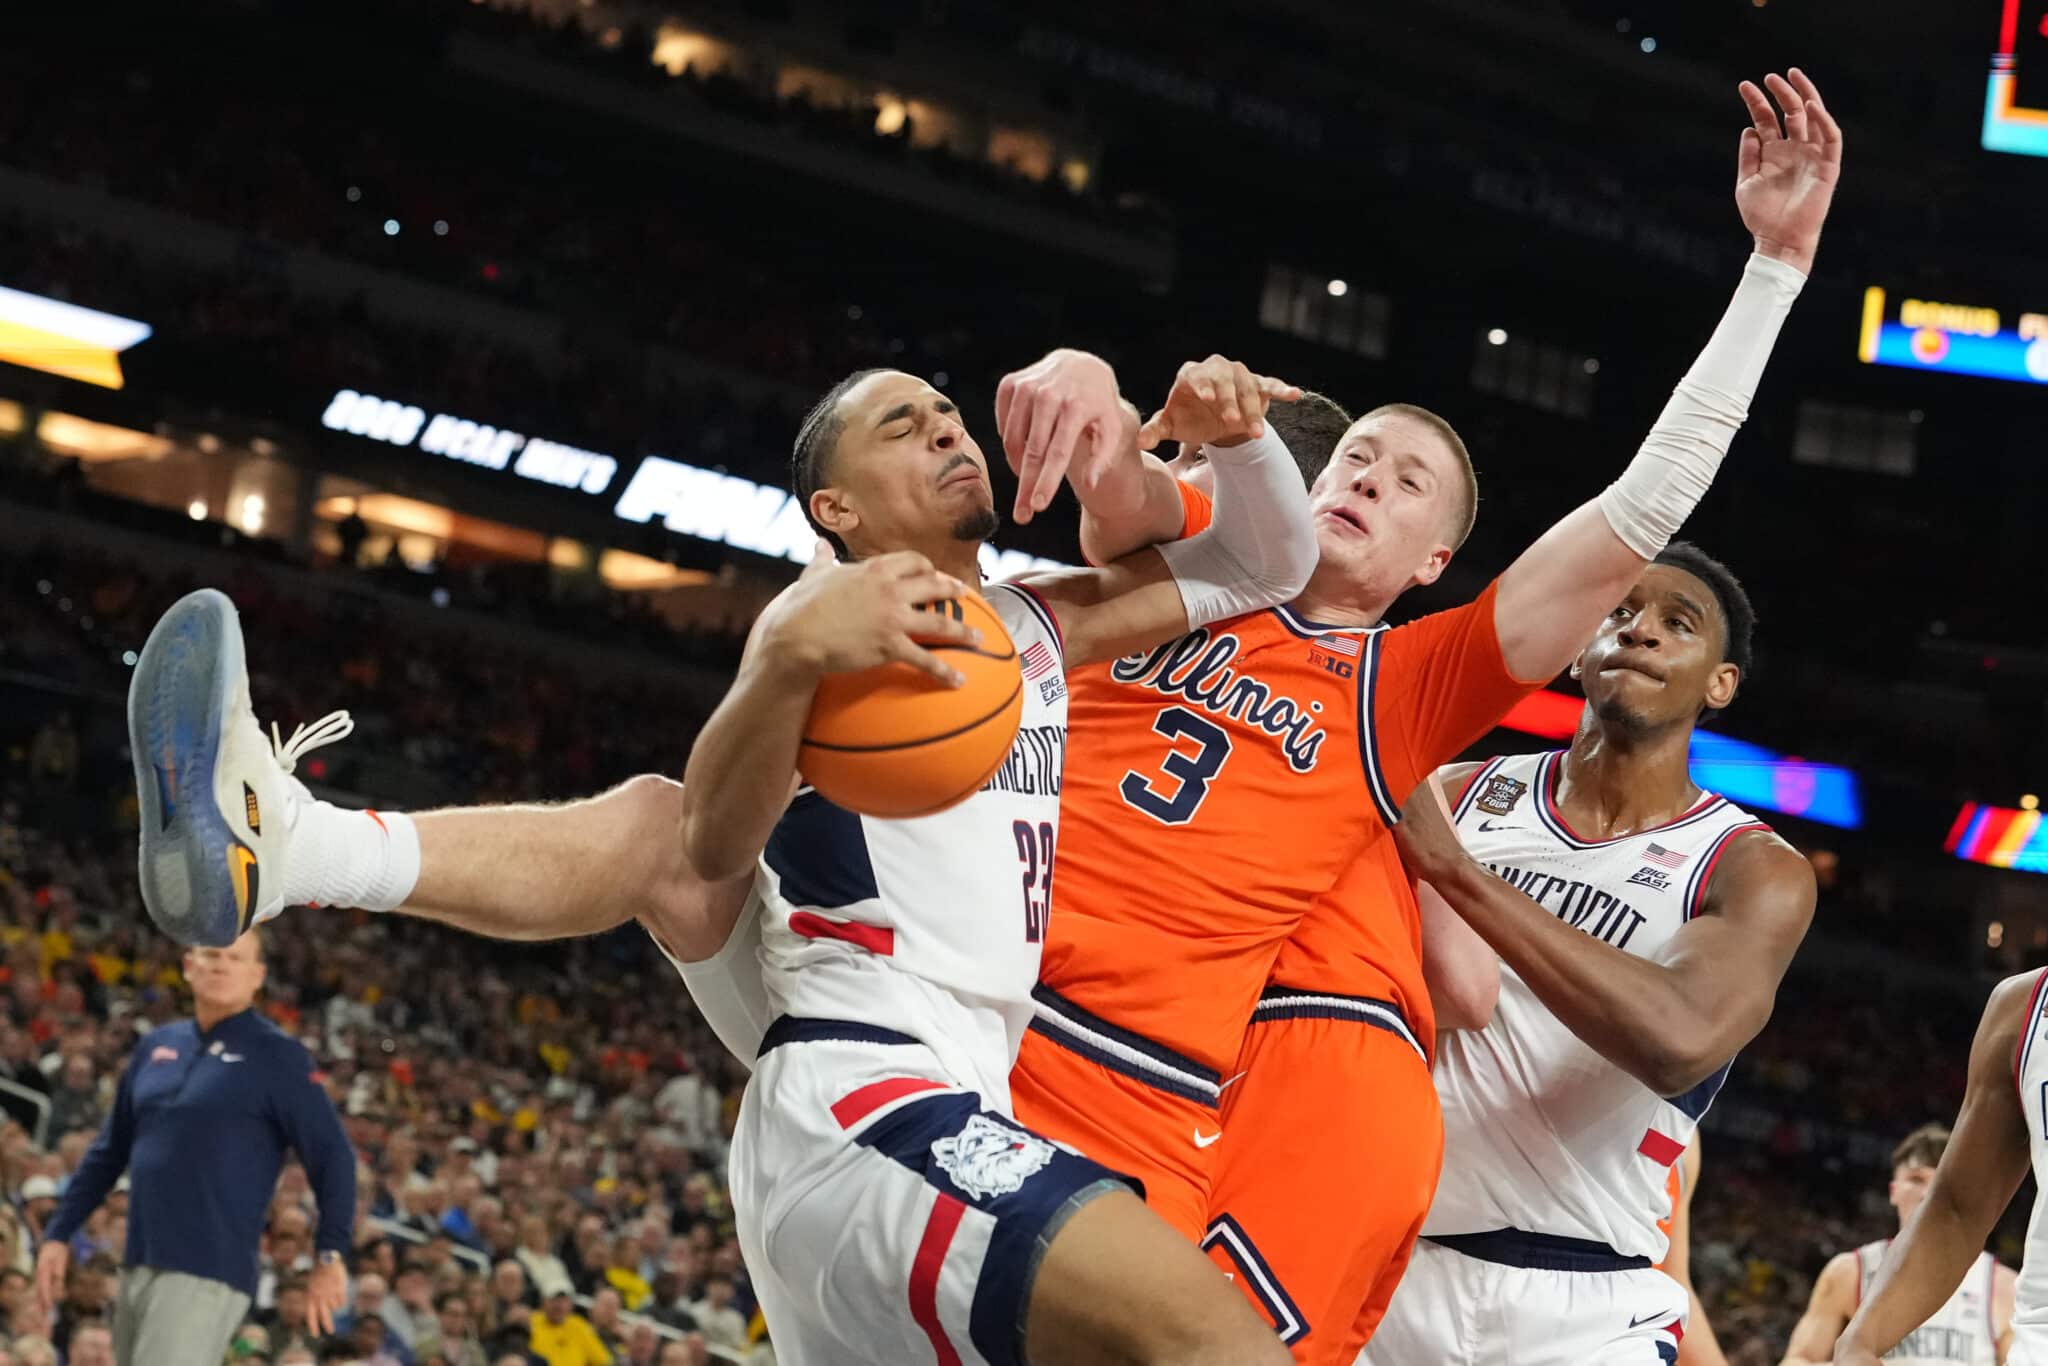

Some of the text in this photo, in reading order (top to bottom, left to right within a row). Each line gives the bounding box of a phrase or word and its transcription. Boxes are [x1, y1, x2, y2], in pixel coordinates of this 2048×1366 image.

[1040, 675, 1059, 693] BIG
[1111, 627, 1326, 774] Illinois
[1118, 705, 1234, 826] 3
[1493, 781, 1520, 796] FINAL
[1483, 796, 1510, 809] FOUR
[1631, 872, 1672, 889] EAST
[1639, 866, 1669, 880] BIG
